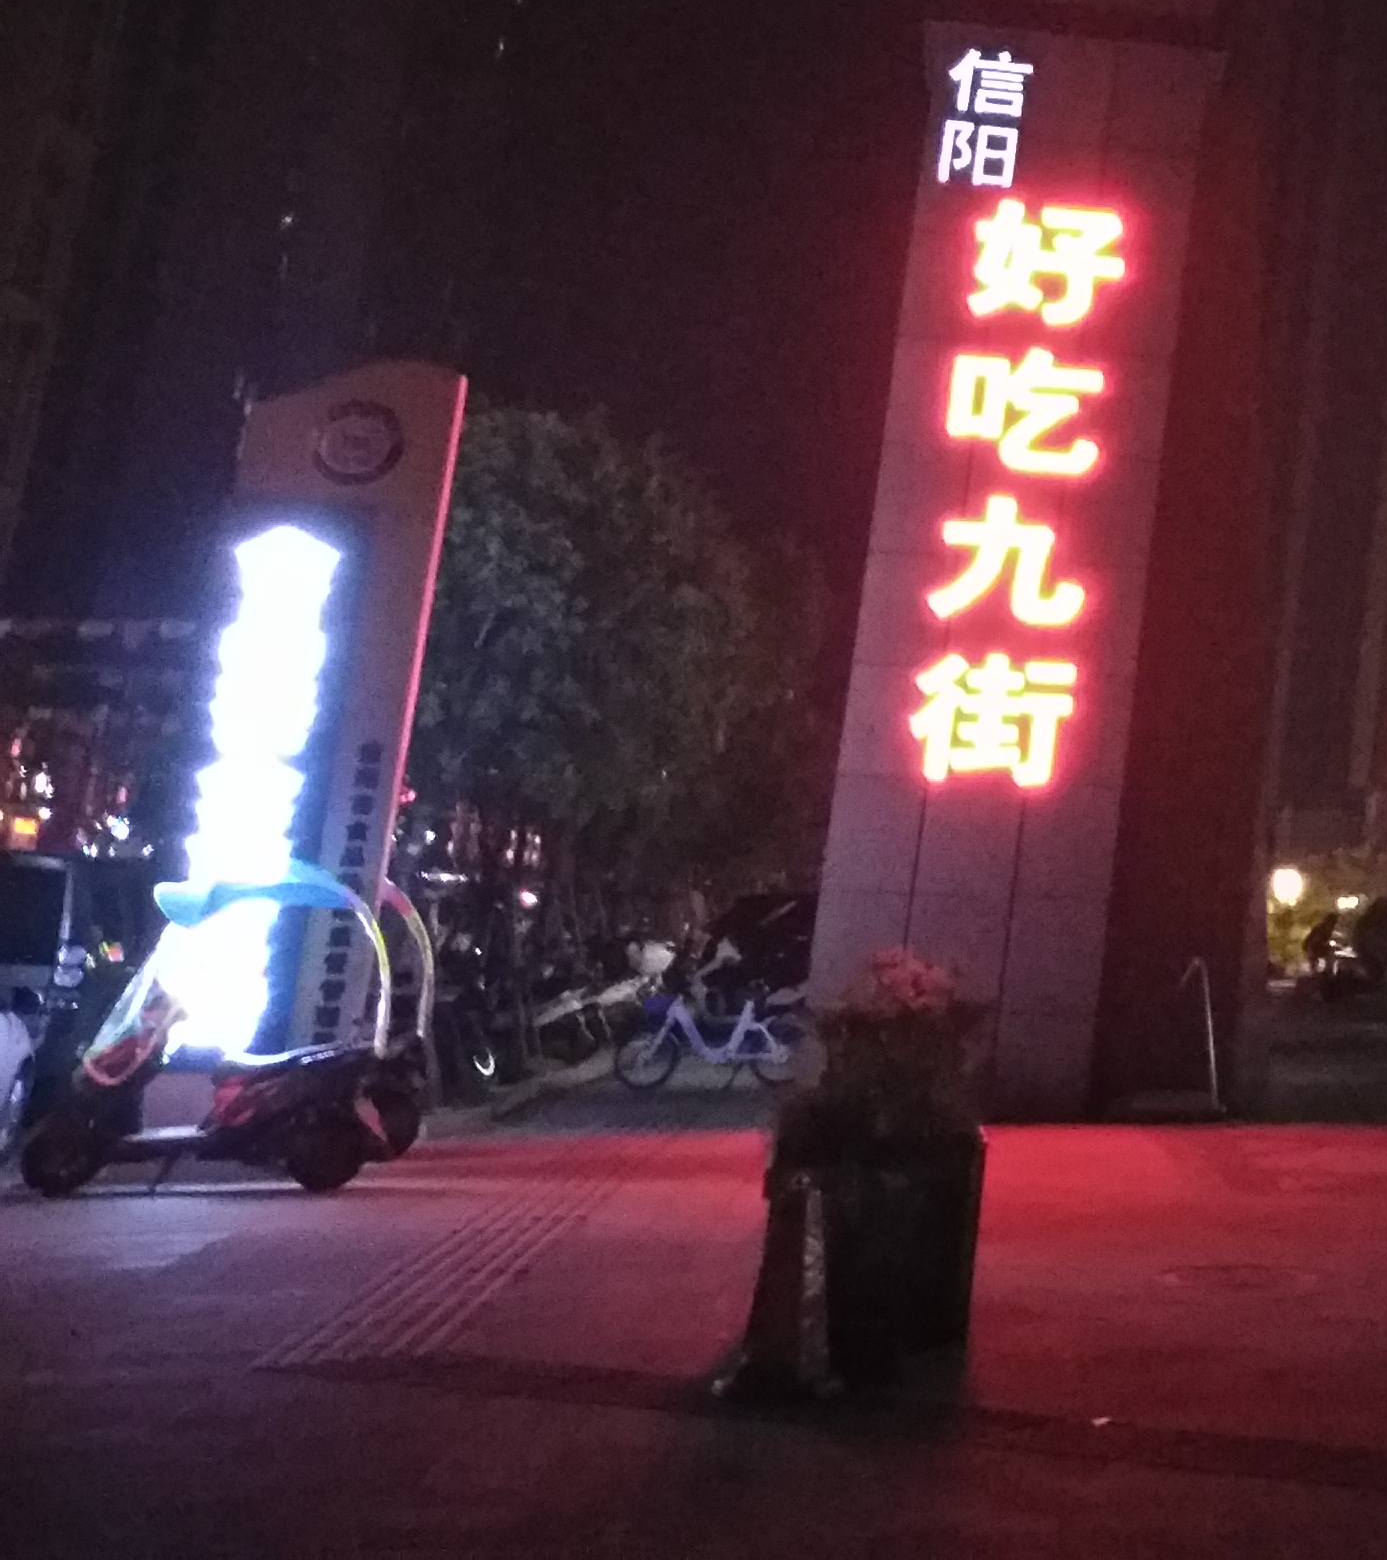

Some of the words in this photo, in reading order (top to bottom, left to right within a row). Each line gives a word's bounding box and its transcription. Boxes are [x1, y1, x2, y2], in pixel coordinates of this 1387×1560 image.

[937, 48, 1034, 189] 信阳
[910, 197, 1127, 788] 好吃九街
